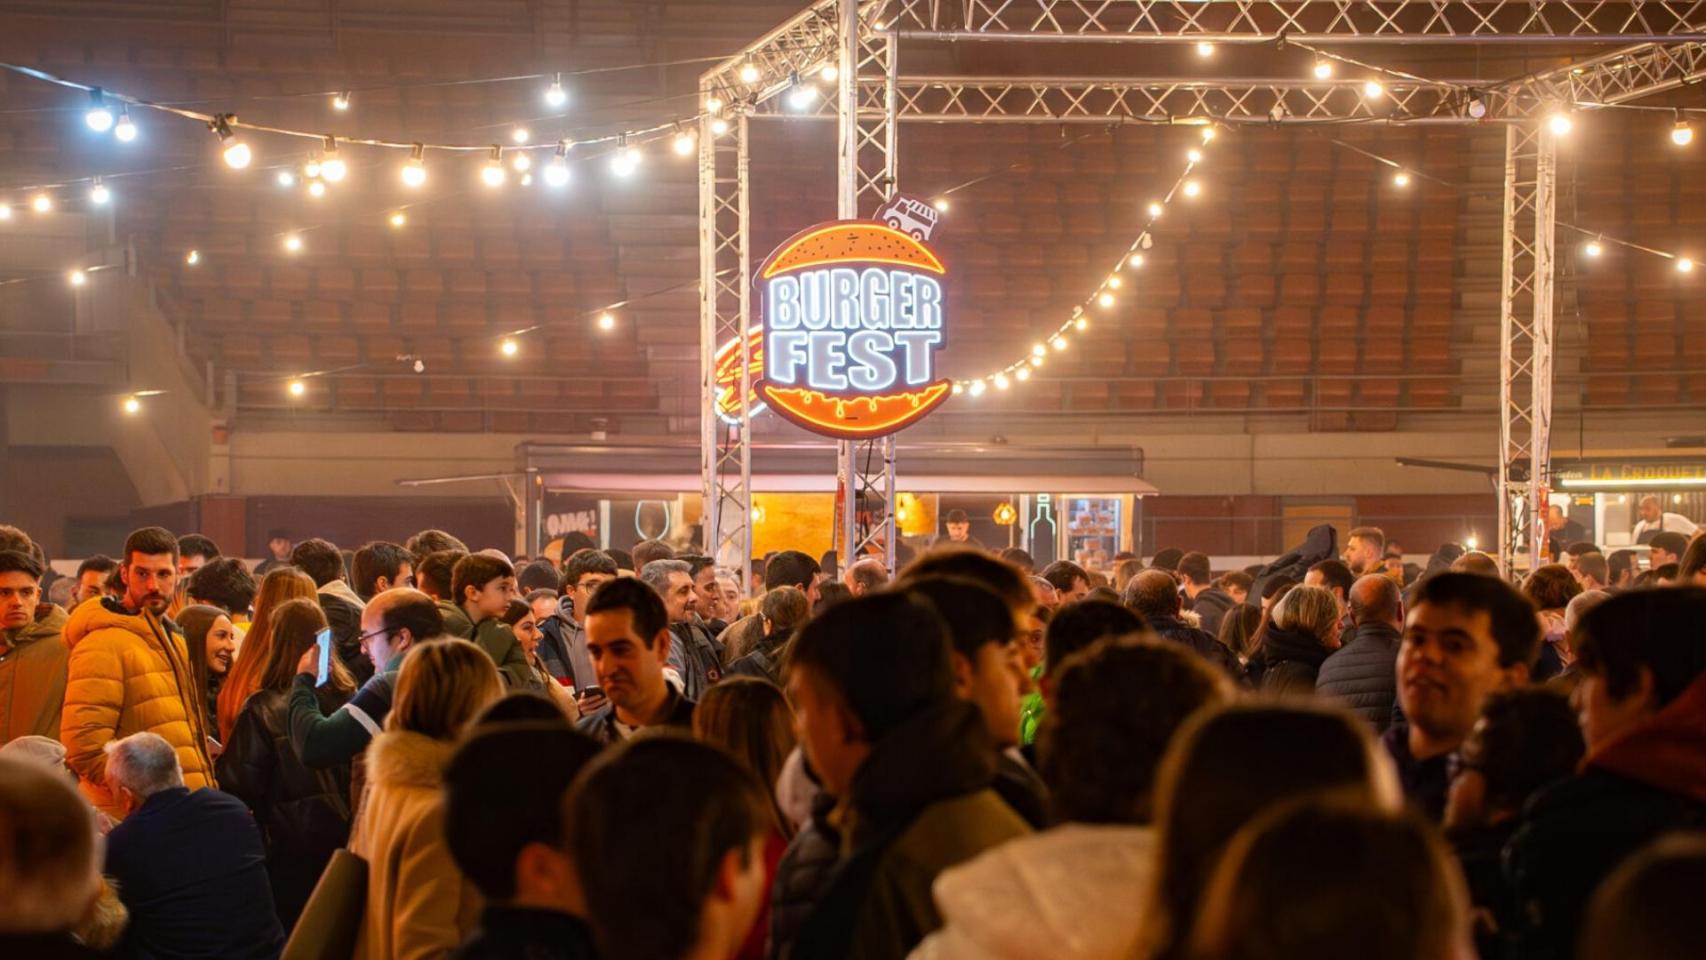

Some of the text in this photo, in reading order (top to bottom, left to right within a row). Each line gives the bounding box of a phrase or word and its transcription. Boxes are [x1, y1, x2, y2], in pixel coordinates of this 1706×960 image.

[769, 268, 942, 330] BURGER
[769, 330, 941, 390] FEST
[1590, 464, 1616, 480] LA
